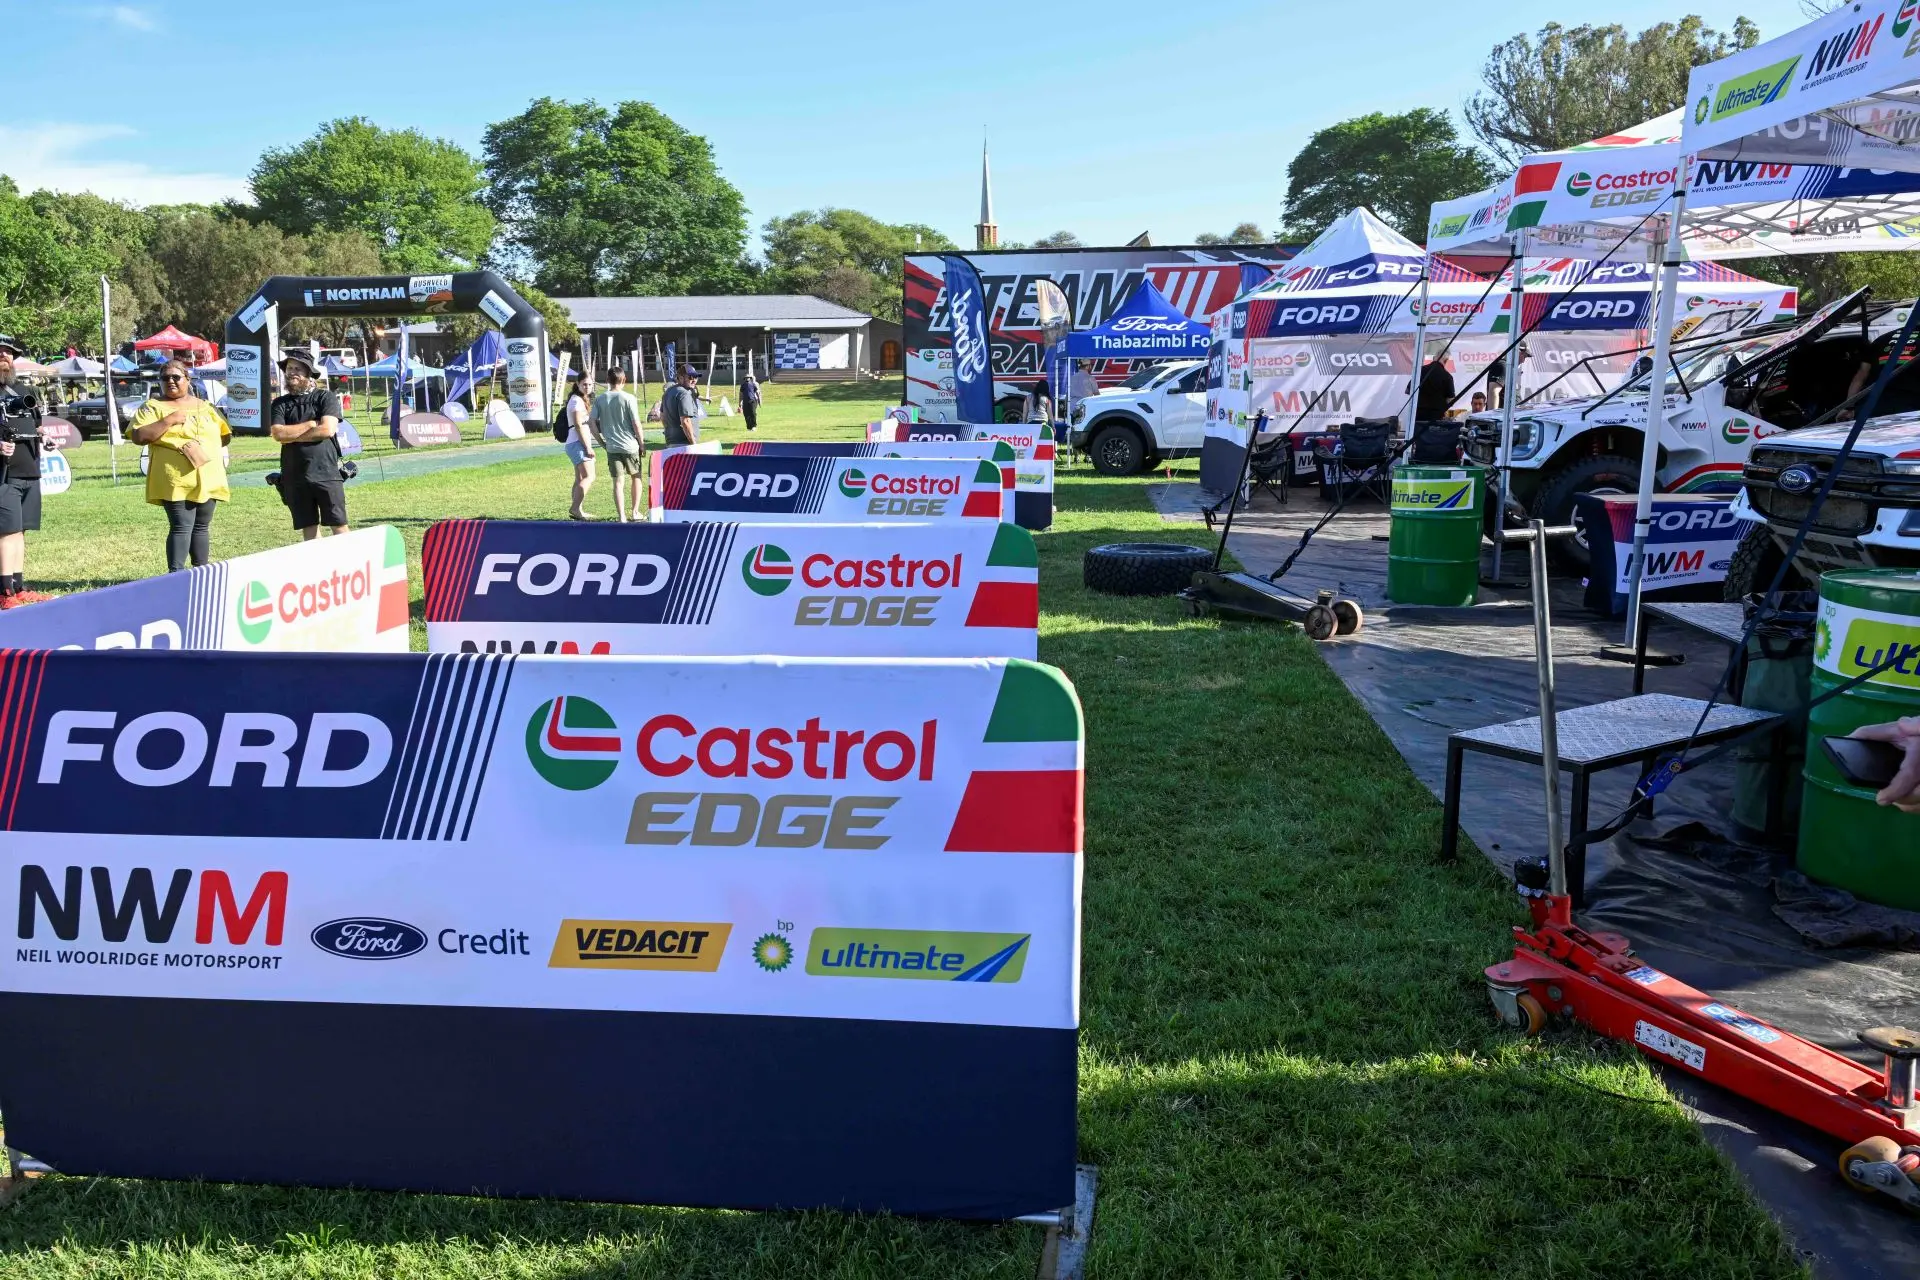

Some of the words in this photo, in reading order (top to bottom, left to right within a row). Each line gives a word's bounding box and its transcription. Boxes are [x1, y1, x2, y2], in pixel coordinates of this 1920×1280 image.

[1805, 13, 1884, 80] NWM
[1810, 72, 1836, 88] WOOLRIDGE
[1836, 62, 1868, 80] MOTORSPORT
[1716, 80, 1770, 114] ultimate
[1595, 166, 1679, 191] Castrol
[1694, 161, 1792, 187] NWM
[1590, 187, 1664, 208] EDGE
[1705, 182, 1743, 193] WOOLRIDGE
[1744, 179, 1787, 189] MOTORSPORT
[1326, 261, 1422, 284] FORD
[326, 286, 406, 301] NORTHAM
[1278, 304, 1361, 326] FORD
[1430, 301, 1486, 314] Castrol
[1551, 299, 1636, 319] FORD
[1111, 315, 1188, 331] Ford
[1426, 315, 1475, 326] EDGE
[1671, 322, 1694, 341] VEDA
[1091, 333, 1187, 349] Thabazimbi
[1191, 335, 1210, 348] Fo
[1681, 422, 1707, 430] NWM
[690, 471, 799, 499] FORD
[871, 473, 961, 496] Castrol
[1391, 488, 1441, 504] ltimate
[866, 497, 949, 517] EDGE
[1649, 508, 1739, 531] FORD
[475, 552, 672, 596] FORD
[801, 552, 963, 589] Castrol
[1663, 571, 1699, 580] MOTORSPORT
[278, 560, 371, 624] Castrol
[794, 595, 943, 626] EDGE
[1825, 601, 1837, 620] bp
[37, 710, 393, 788] FORD
[636, 713, 938, 781] Castrol
[625, 791, 903, 850] EDGE
[17, 863, 289, 947] NWM
[776, 919, 794, 934] bp
[334, 922, 403, 955] Ford
[437, 928, 530, 956] Credit
[575, 927, 709, 957] VEDACIT
[16, 948, 52, 964] NEIL
[57, 950, 160, 967] WOOLRIDGE
[163, 953, 282, 970] MOTORSPORT
[821, 943, 965, 973] ultimate
